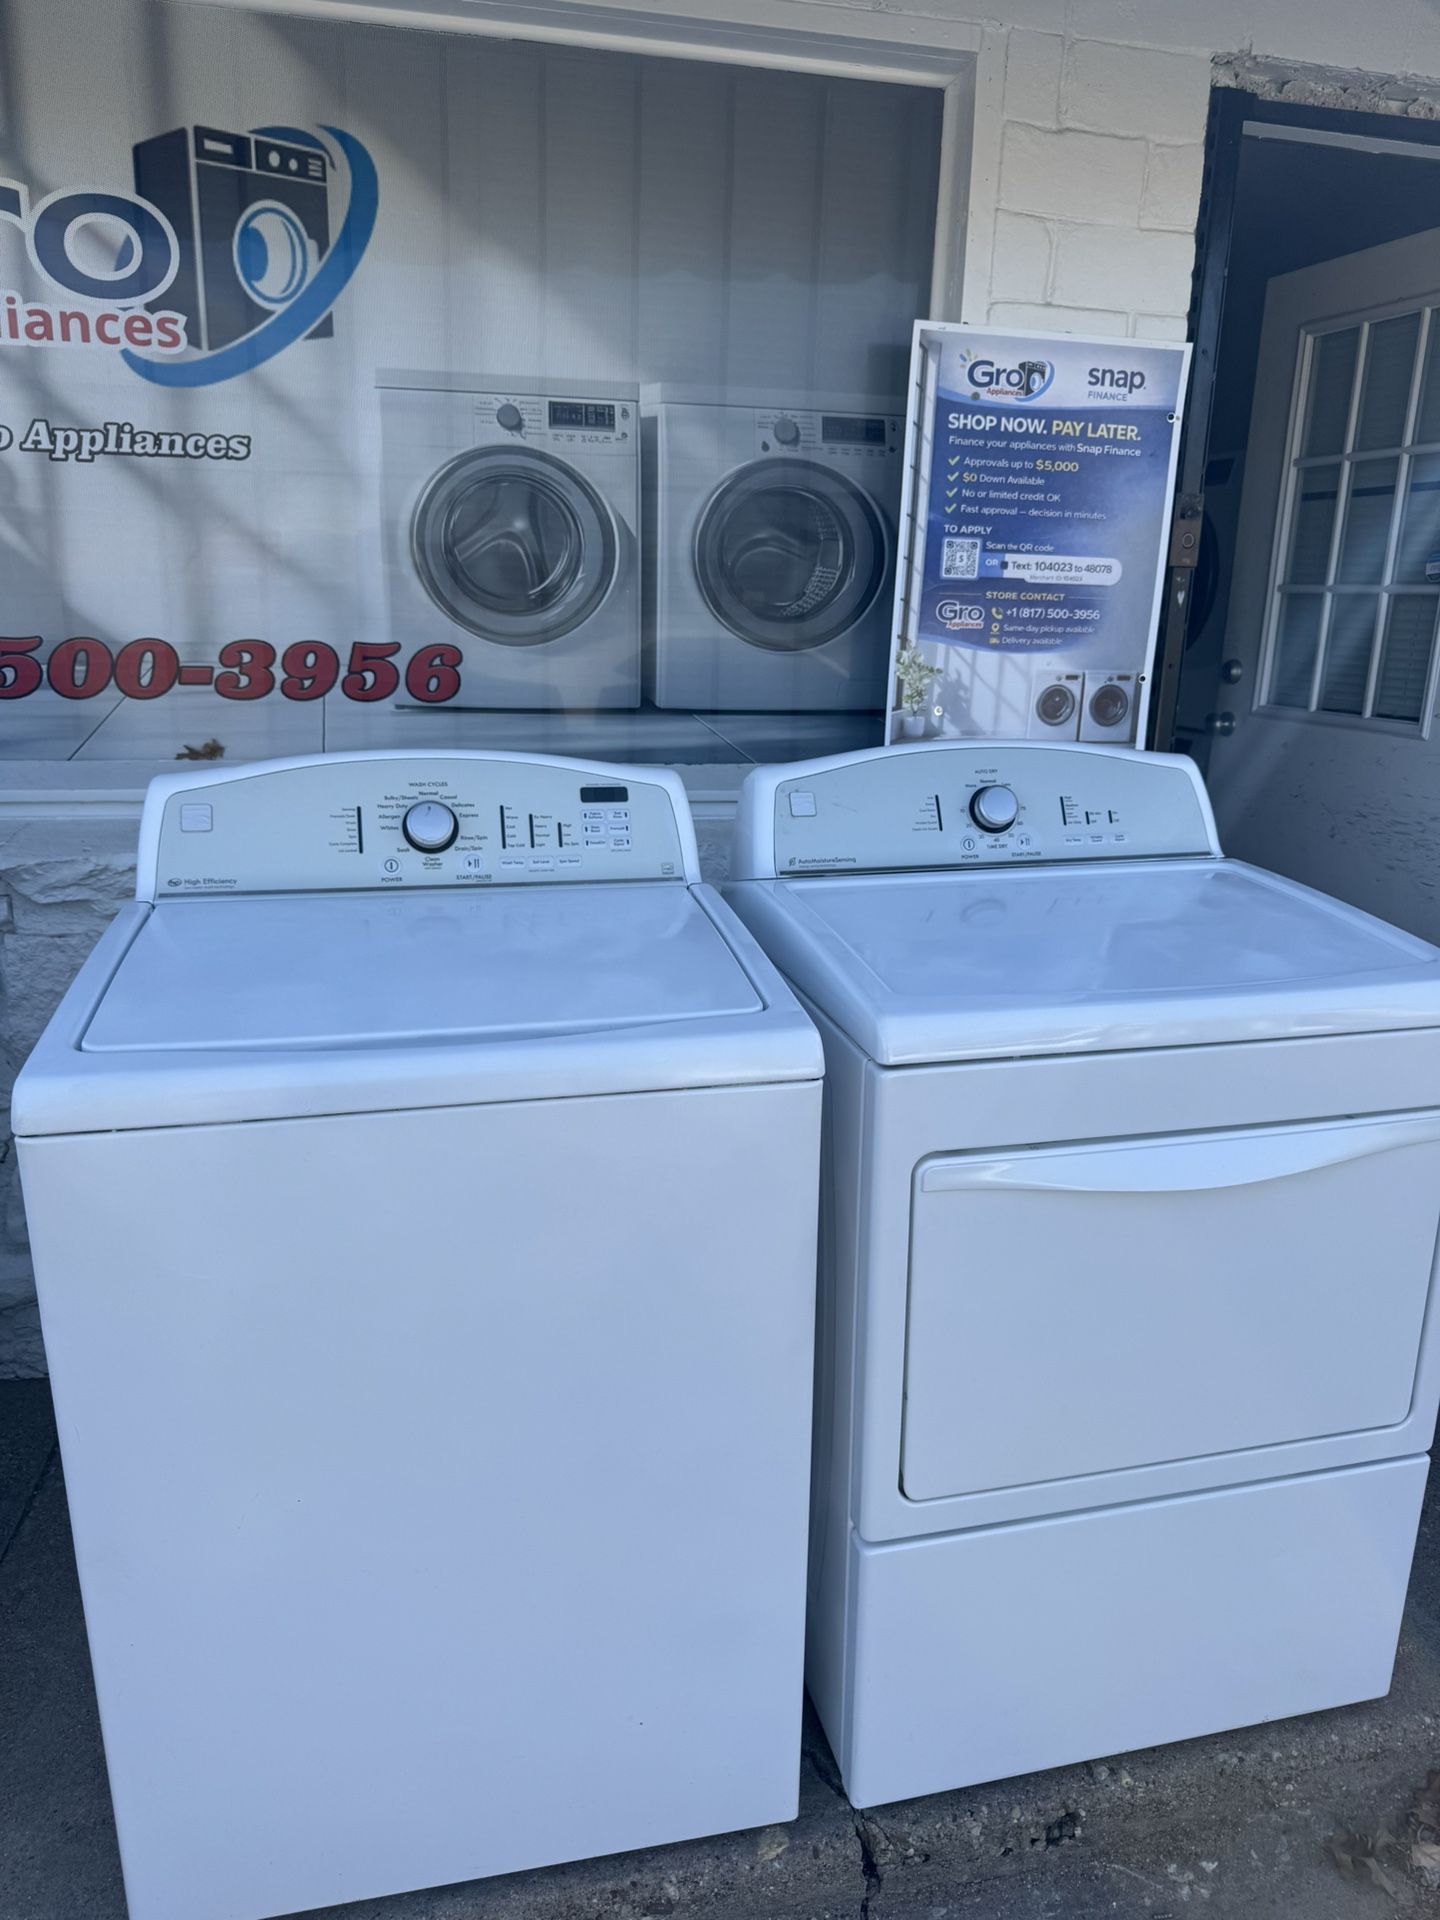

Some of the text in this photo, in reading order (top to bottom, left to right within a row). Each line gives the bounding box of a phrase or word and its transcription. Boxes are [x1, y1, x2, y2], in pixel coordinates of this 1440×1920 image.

[0, 295, 182, 349] iances
[967, 360, 1024, 388] Gro
[1088, 367, 1147, 394] snap
[986, 387, 1023, 397] Appliances
[1087, 390, 1128, 401] FINANCE
[948, 413, 1142, 441] SHOP NOW. PAY LATER.
[20, 419, 250, 462] Appliances
[949, 436, 1141, 457] Finance your appliances with Snap Finance
[964, 457, 1080, 473] Approvals up to $5,000
[962, 471, 1045, 486] $0 Down Available
[962, 489, 975, 498] No
[989, 489, 1017, 500] limited
[1019, 492, 1045, 502] credit
[1046, 493, 1061, 503] OK
[960, 504, 979, 514] Fast
[980, 506, 1018, 517] approval
[1028, 508, 1063, 518] decision
[1064, 510, 1073, 518] in
[1074, 511, 1107, 520] minutes
[944, 524, 993, 535] TO APPLY
[985, 541, 1006, 550] Scan
[1019, 543, 1034, 552] QR
[1034, 544, 1055, 553] code
[985, 558, 1113, 575] OR Text: 104023 to 48078
[985, 591, 1065, 601] STORE CONTACT
[937, 600, 984, 622] Gro
[1006, 607, 1100, 620] +1 (817) 500-3956
[1003, 624, 1040, 634] Same-day
[1039, 626, 1063, 634] pickup
[1002, 636, 1030, 646] Delivery
[0, 636, 463, 702] 500-3956
[460, 834, 488, 842] Rinse/Spin
[183, 877, 238, 886] High Efficiency
